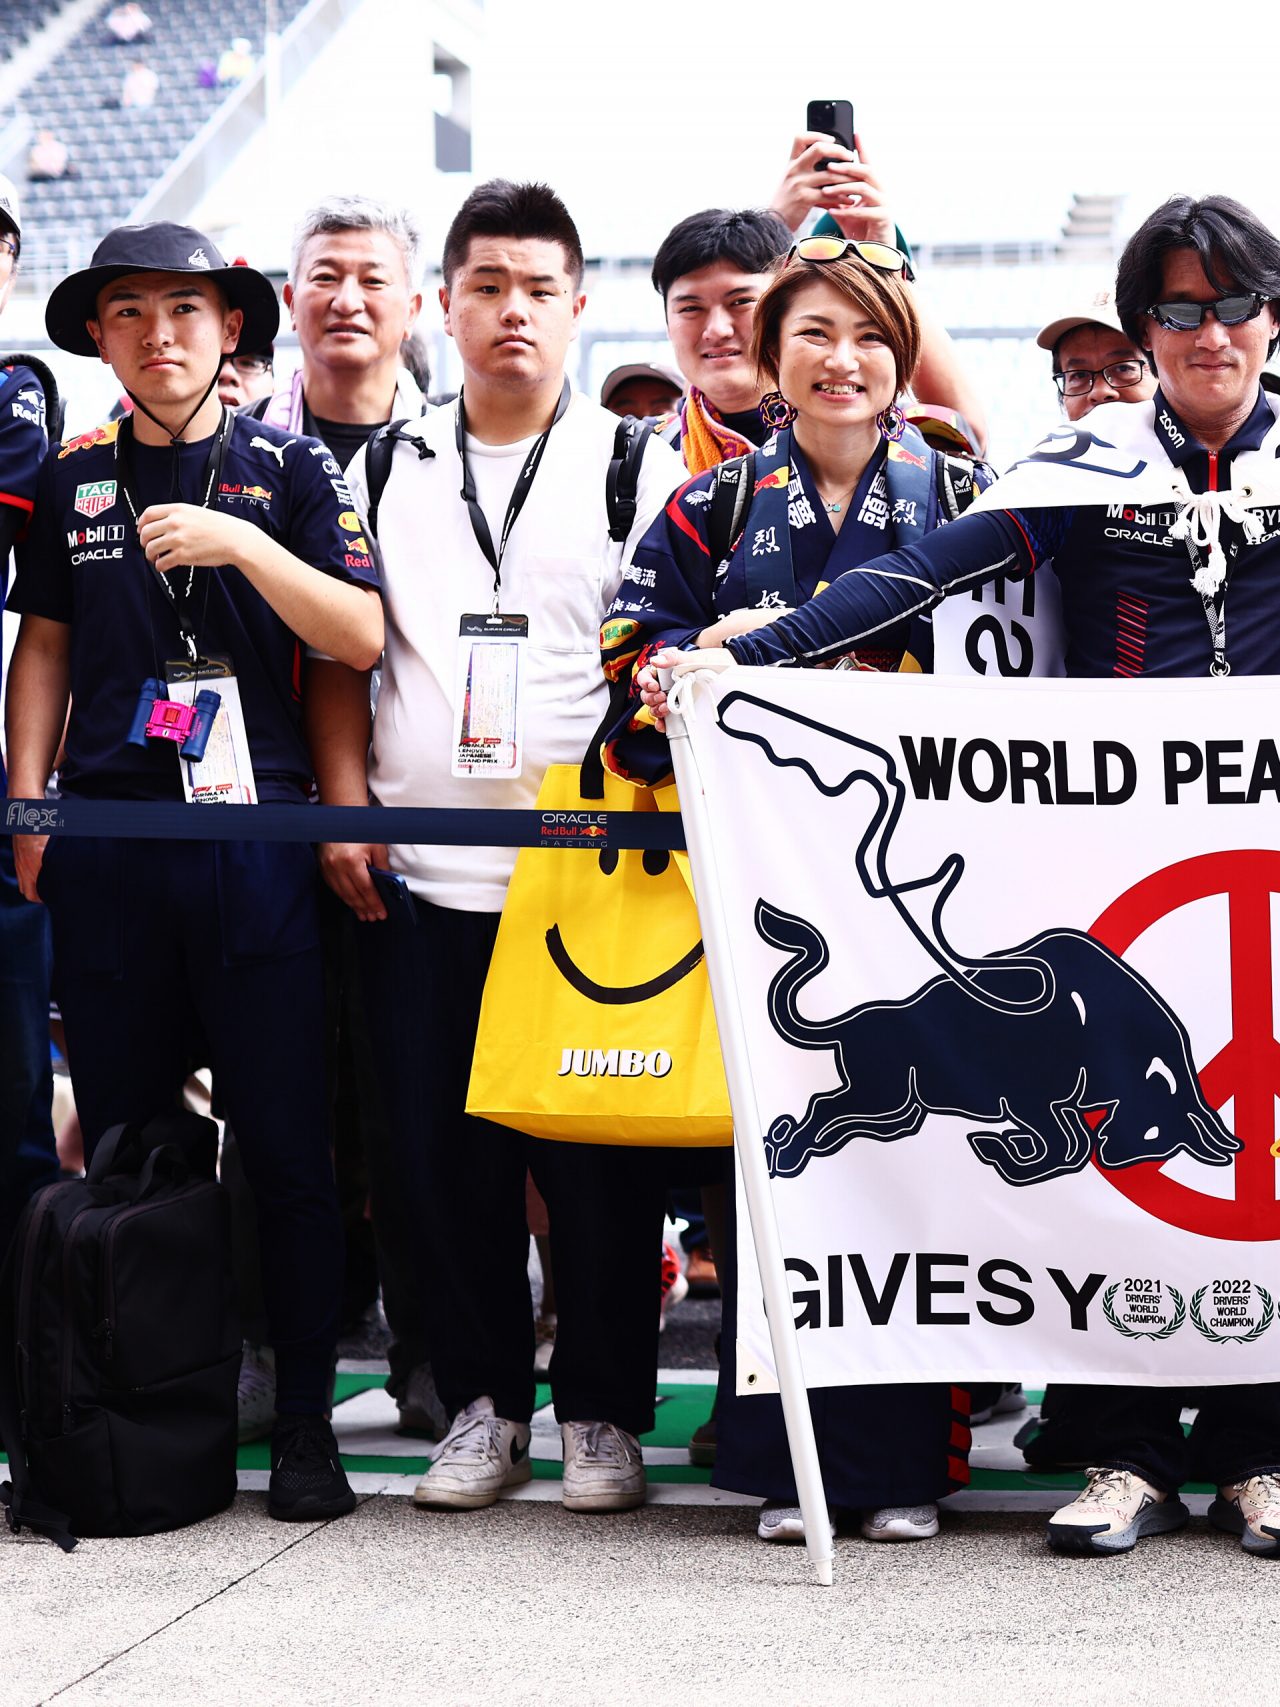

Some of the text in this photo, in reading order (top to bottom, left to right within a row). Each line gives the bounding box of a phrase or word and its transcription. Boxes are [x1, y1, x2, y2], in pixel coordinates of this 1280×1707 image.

[1159, 410, 1186, 448] zoom
[79, 483, 113, 497] TAG
[222, 483, 241, 493] Bull
[76, 496, 113, 515] HEUER
[1106, 504, 1156, 525] Mobil
[67, 525, 106, 548] Mobil
[1104, 528, 1174, 547] ORACLE
[71, 547, 124, 565] ORACLE
[344, 553, 370, 568] Red
[899, 735, 1137, 805] WORLD
[541, 813, 608, 824] ORACLE
[541, 826, 577, 836] Red Bull
[557, 1048, 672, 1078] JUMBO
[763, 1252, 1035, 1330] GIVES
[1124, 1278, 1161, 1293] 2021
[1212, 1280, 1251, 1294] 2022
[1129, 1304, 1159, 1314] WORLD
[1217, 1306, 1246, 1316] WORLD
[1123, 1314, 1166, 1325] CHAMPION
[1210, 1317, 1254, 1327] CHAMPION
